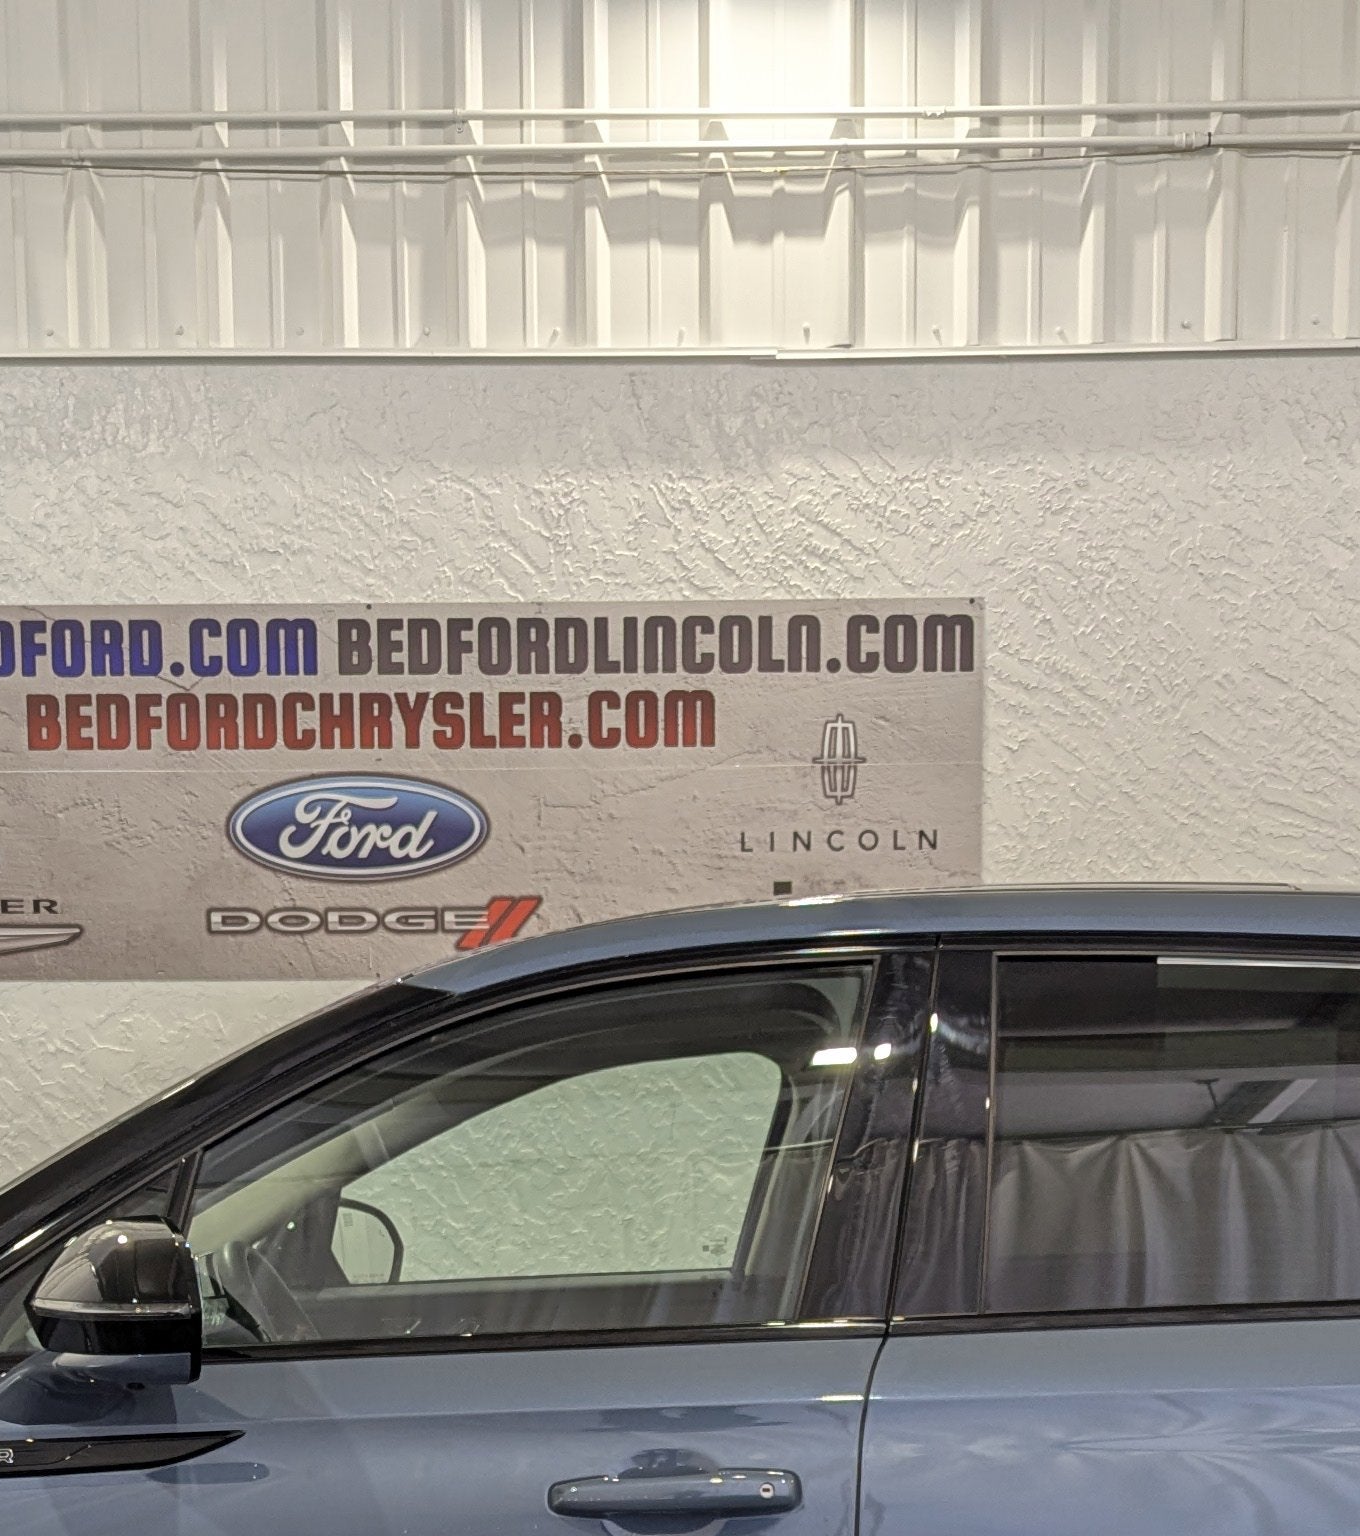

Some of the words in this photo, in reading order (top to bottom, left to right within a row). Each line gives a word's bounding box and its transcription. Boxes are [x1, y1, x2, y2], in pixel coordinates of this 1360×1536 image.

[338, 614, 976, 675] BEDFORDLINCOLN.COM
[26, 689, 716, 751] BEDFORDCHRYSLER.COM
[278, 792, 439, 860] Ford
[739, 828, 939, 852] LINCOLN
[207, 906, 491, 934] DODGE
